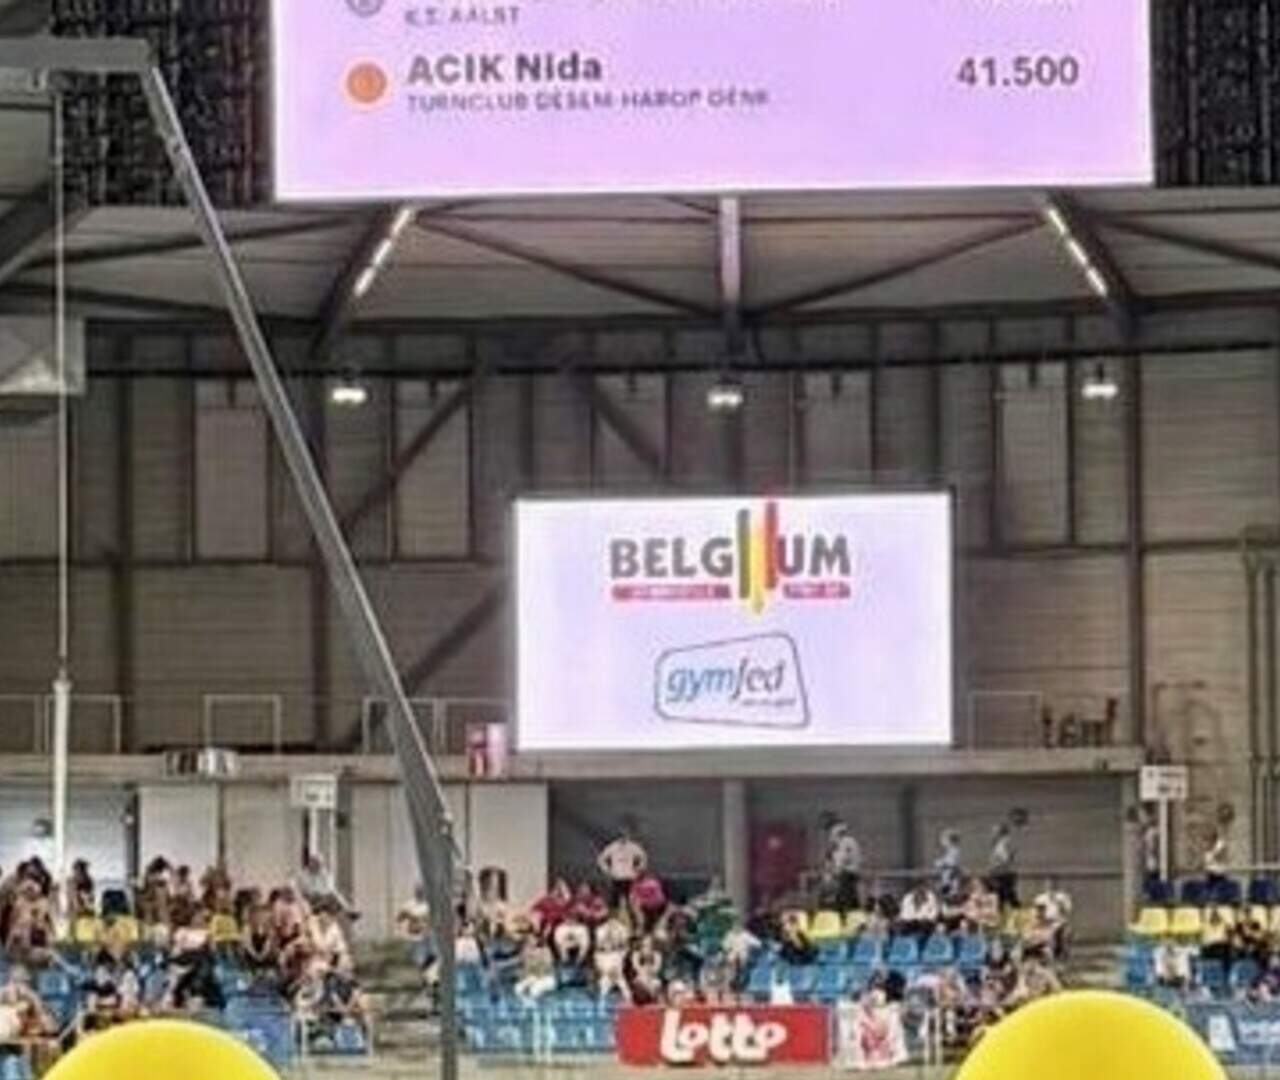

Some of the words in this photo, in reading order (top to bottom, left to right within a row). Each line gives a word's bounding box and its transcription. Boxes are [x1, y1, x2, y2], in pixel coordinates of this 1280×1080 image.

[407, 55, 505, 83] ACIK
[515, 53, 602, 81] Nida
[957, 55, 1080, 87] 41.500
[665, 656, 787, 704] gymfed
